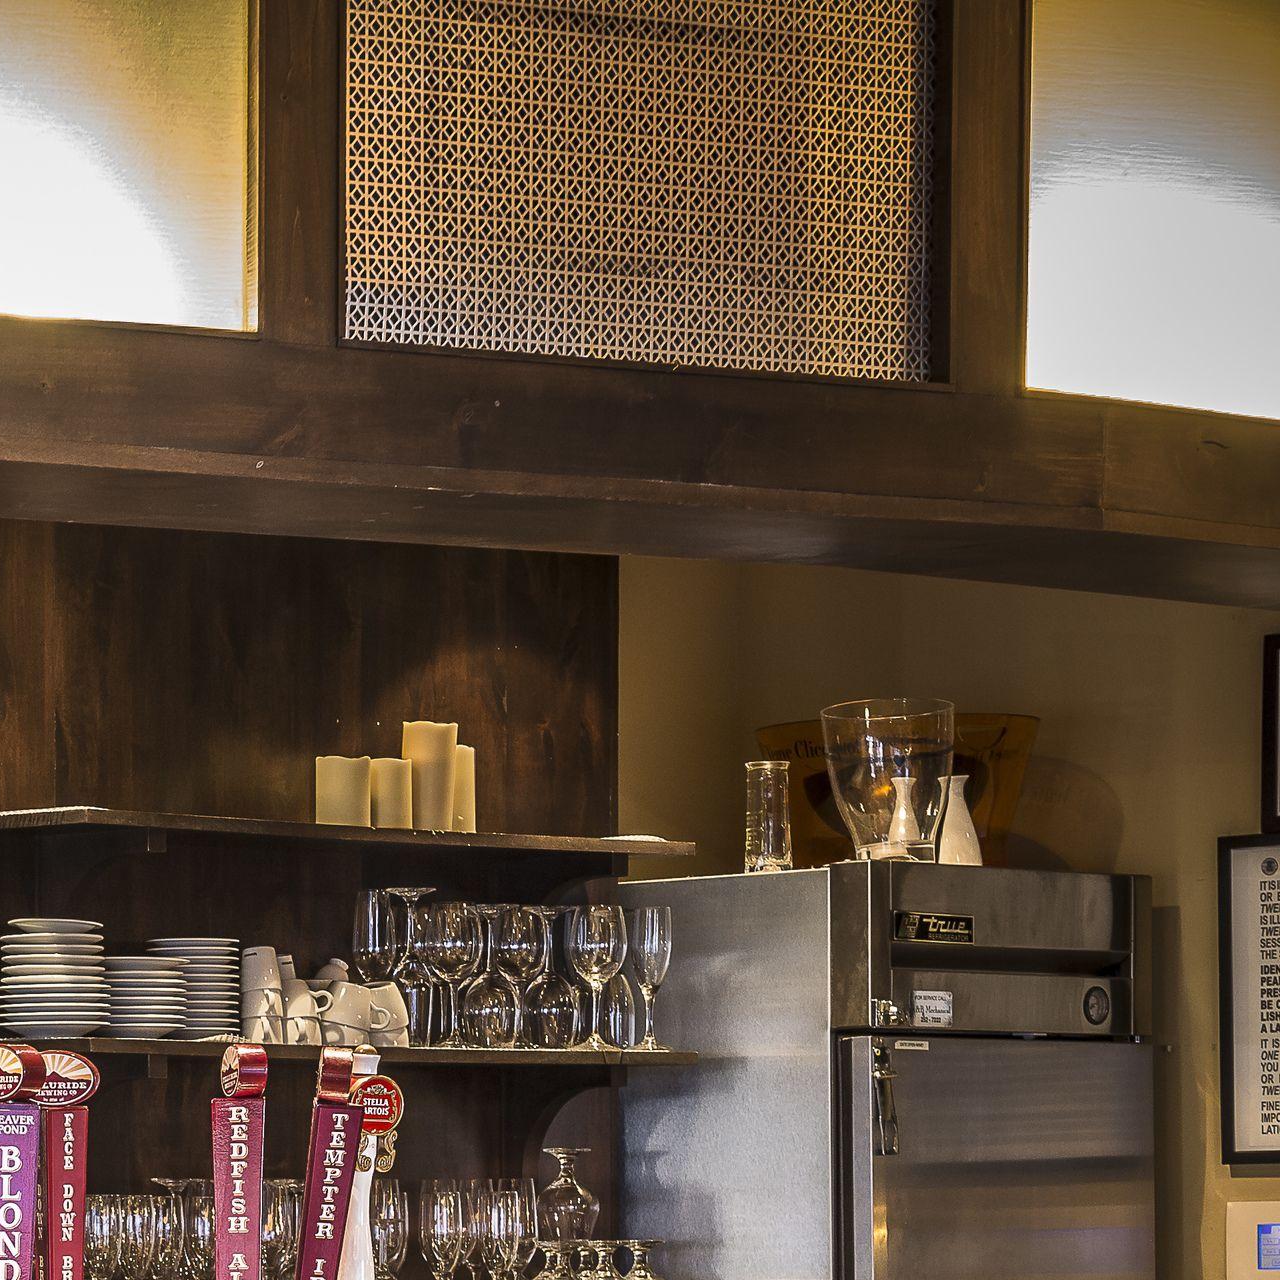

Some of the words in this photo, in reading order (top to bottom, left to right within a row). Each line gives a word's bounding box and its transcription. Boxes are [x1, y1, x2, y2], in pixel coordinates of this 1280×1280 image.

[1260, 892, 1273, 902] OR
[923, 916, 969, 933] true
[1260, 915, 1268, 925] IS
[1260, 950, 1277, 960] THE
[1260, 1000, 1273, 1010] BE
[1260, 1024, 1267, 1033] A
[1260, 1039, 1268, 1049] IT
[1271, 1039, 1280, 1049] IS
[1260, 1051, 1279, 1060] ONE
[1260, 1062, 1279, 1072] YOU
[1260, 1074, 1274, 1084] OR
[363, 1098, 389, 1106] STELLA
[63, 1113, 74, 1170] FACE
[227, 1106, 250, 1234] REDFISH
[315, 1113, 349, 1240] TEMPTER
[59, 1184, 76, 1242] DOWN
